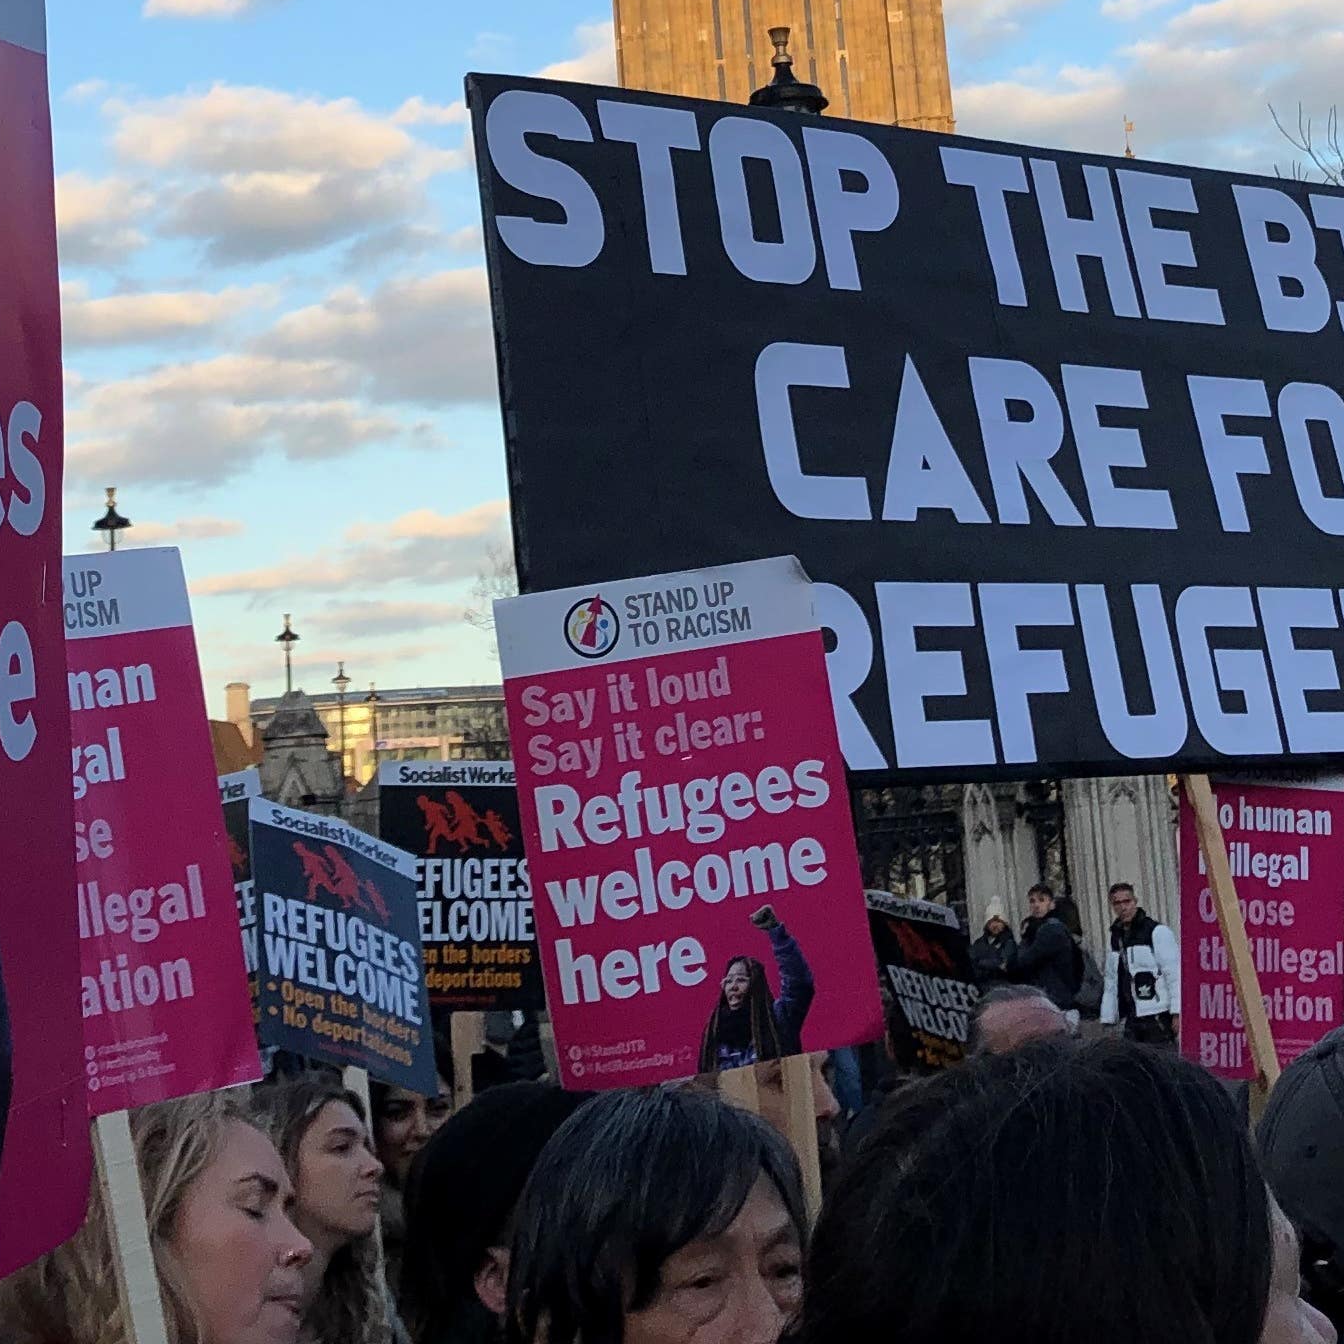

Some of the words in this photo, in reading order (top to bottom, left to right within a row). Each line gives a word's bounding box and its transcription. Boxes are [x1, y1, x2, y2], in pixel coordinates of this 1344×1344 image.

[485, 90, 899, 291] STOP
[939, 147, 1225, 326] THE
[755, 341, 1177, 529] CARE
[70, 570, 102, 598] UP
[624, 586, 698, 619] STAND
[704, 581, 734, 607] UP
[628, 621, 657, 647] TO
[667, 606, 751, 643] RACISM
[521, 685, 595, 729] Say
[607, 673, 638, 714] it
[646, 656, 731, 707] loud
[527, 734, 603, 779] Say
[613, 722, 646, 763] it
[655, 710, 765, 756] clear:
[534, 759, 830, 852] Refugees
[1239, 795, 1332, 835] human
[545, 837, 827, 928] welcome
[1229, 842, 1309, 888] illegal
[263, 892, 420, 982] REFUGEES
[442, 944, 466, 965] the
[472, 944, 531, 965] borders
[82, 954, 194, 1018] ation
[264, 933, 423, 1025] WELCOME
[425, 967, 522, 992] deportations
[556, 936, 707, 1005] here
[281, 981, 325, 1010] Open
[330, 994, 357, 1018] the
[363, 1004, 421, 1046] borders
[283, 1005, 307, 1029] No
[312, 1013, 413, 1067] deportations
[1199, 984, 1334, 1028] Migation
